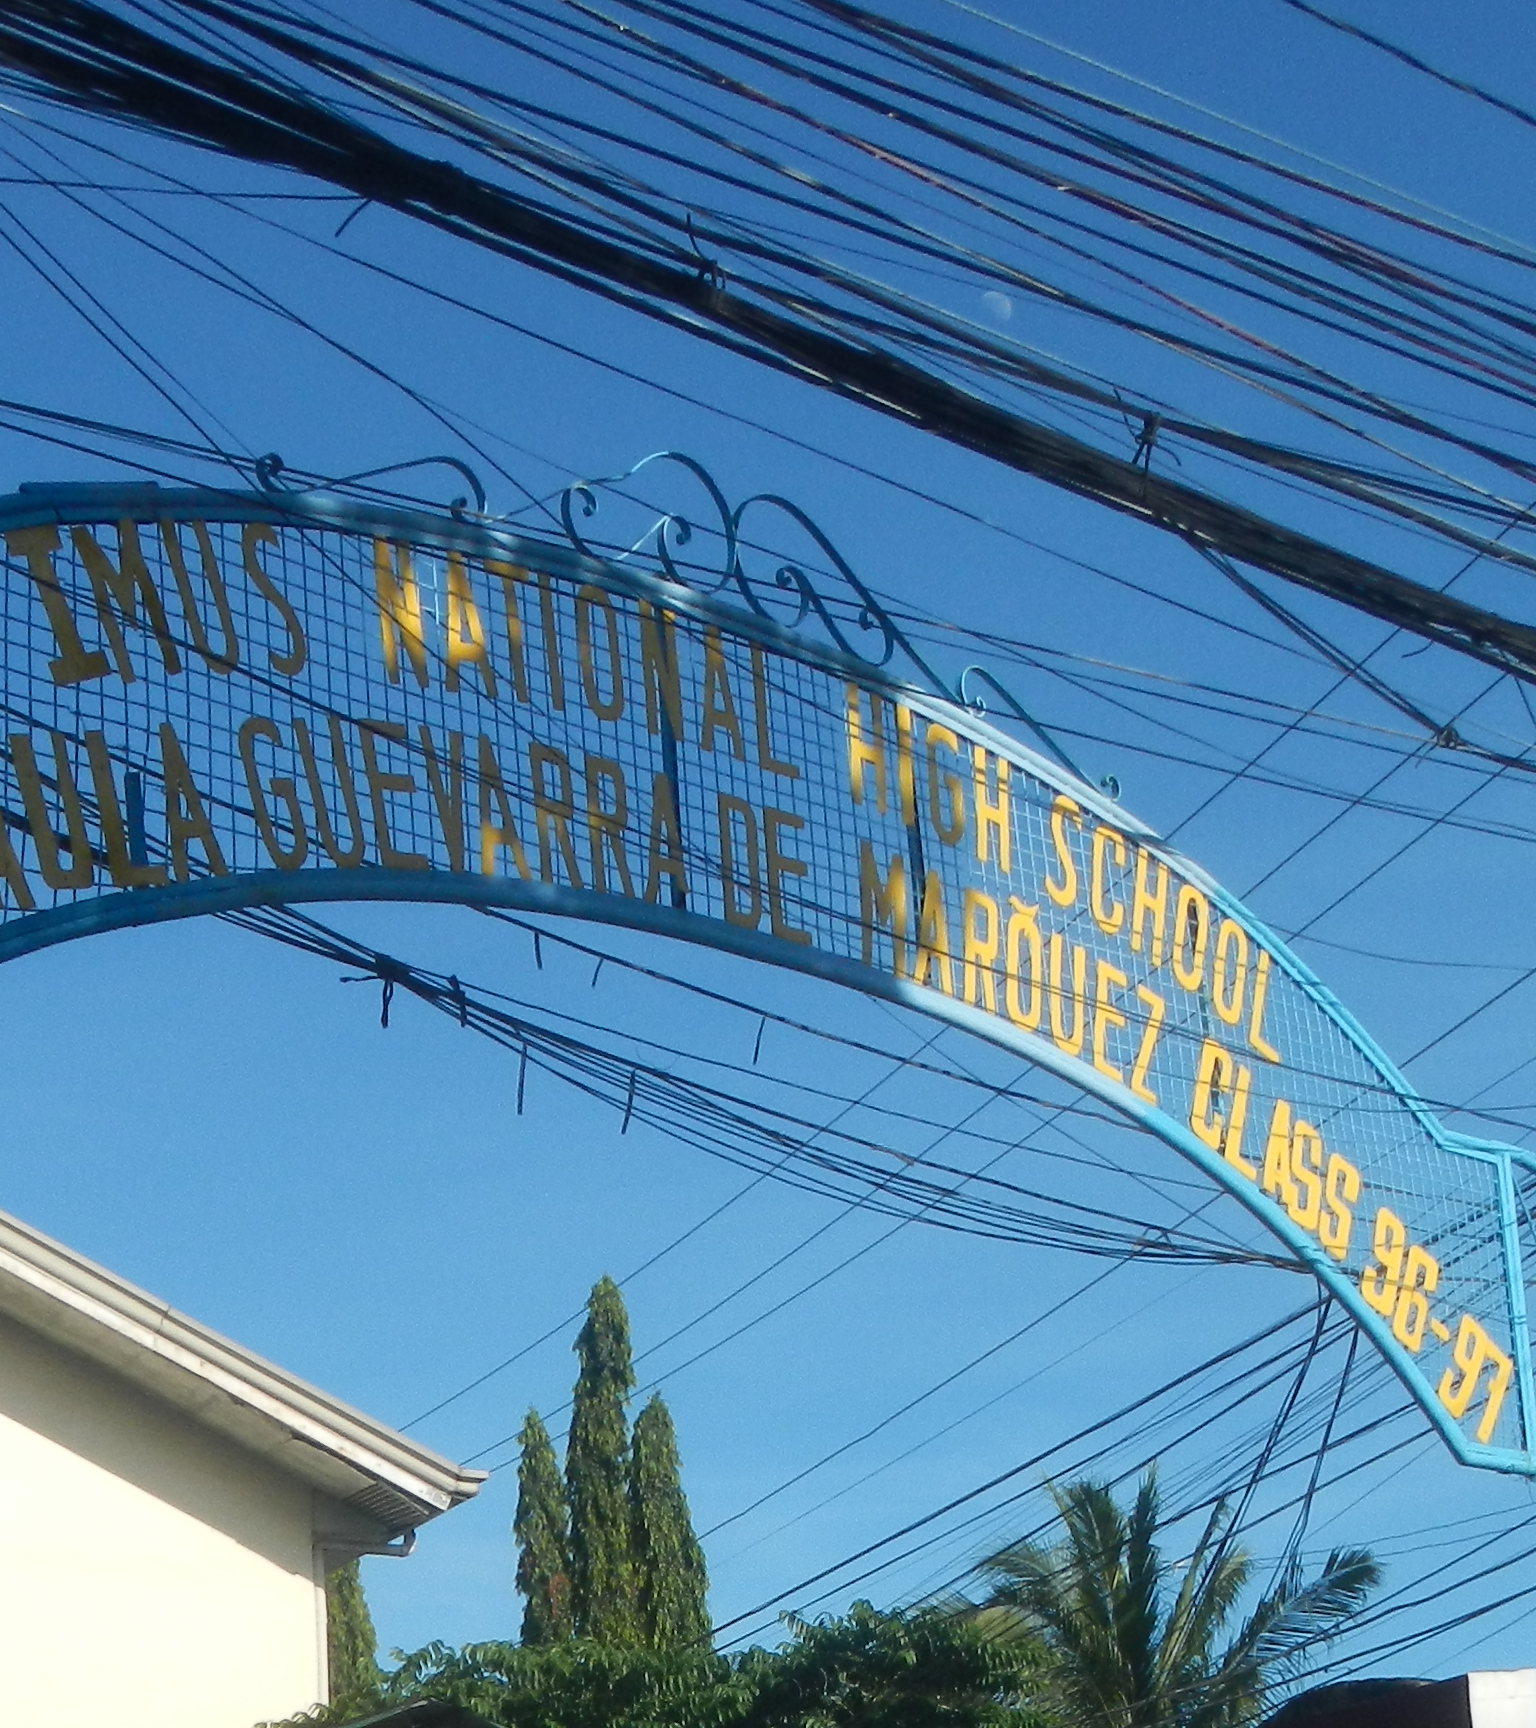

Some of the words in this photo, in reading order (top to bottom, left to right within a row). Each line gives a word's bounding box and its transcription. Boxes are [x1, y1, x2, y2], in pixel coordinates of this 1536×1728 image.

[4, 519, 309, 687] IMUS
[373, 535, 800, 780] NATIONAL
[845, 683, 1012, 873] HIGH
[1043, 793, 1281, 1065] SCHOOL
[238, 714, 688, 904] GUEVARRA
[717, 790, 813, 947] DE
[1189, 1036, 1361, 1263] CLASS
[1360, 1206, 1513, 1445] 96-97
